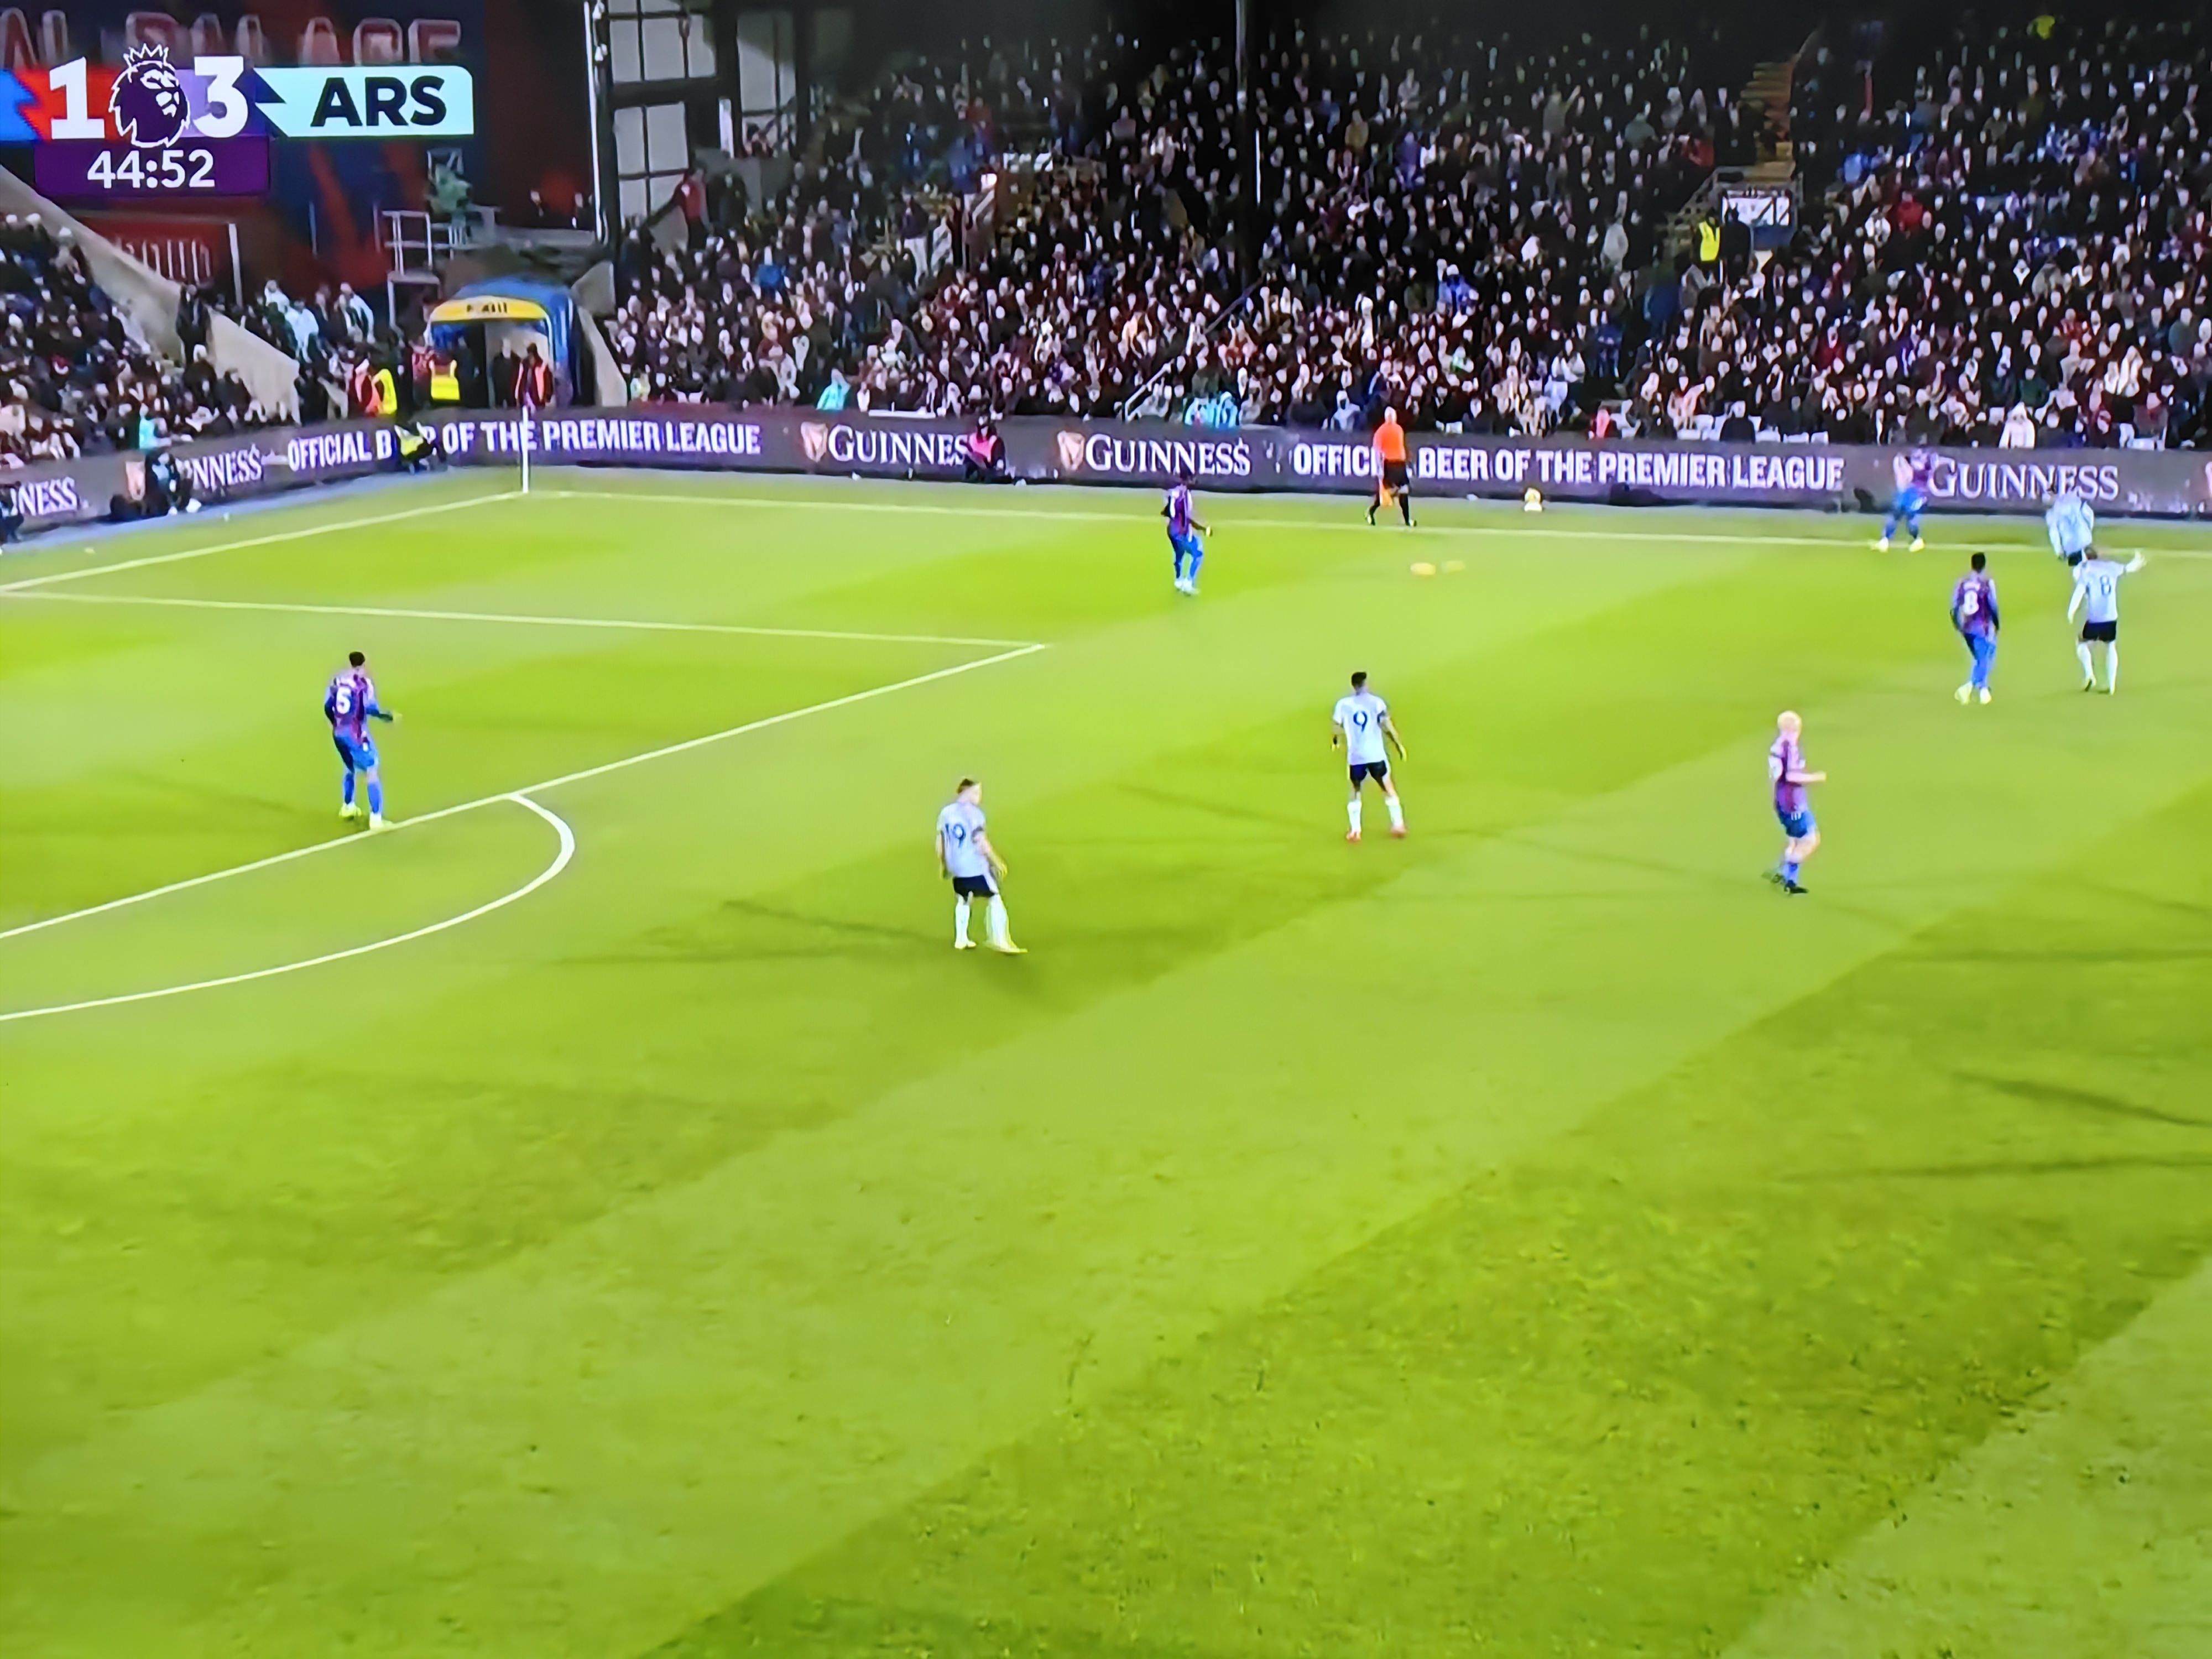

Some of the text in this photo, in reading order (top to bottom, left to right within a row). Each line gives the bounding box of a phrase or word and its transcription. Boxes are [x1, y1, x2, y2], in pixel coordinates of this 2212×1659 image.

[50, 56, 249, 139] 1 3
[310, 76, 446, 128] ARS
[87, 150, 215, 189] 44:52
[288, 431, 372, 471] OFFICIAL
[443, 422, 474, 454] OF
[481, 420, 536, 452] THE
[542, 419, 662, 452] PREMIER
[666, 421, 761, 454] LEAGUE
[828, 424, 969, 466] GUINNES
[1086, 434, 1251, 477] GUINNESS
[1418, 446, 1489, 481] BEER
[1493, 448, 1530, 482] OF
[1534, 449, 1593, 484] THE
[1598, 451, 1726, 488] PREMIER
[1733, 454, 1845, 491] LEAGUE
[1928, 456, 2119, 500] GUINNESS
[336, 686, 352, 714] 5
[1353, 711, 1368, 733] 9
